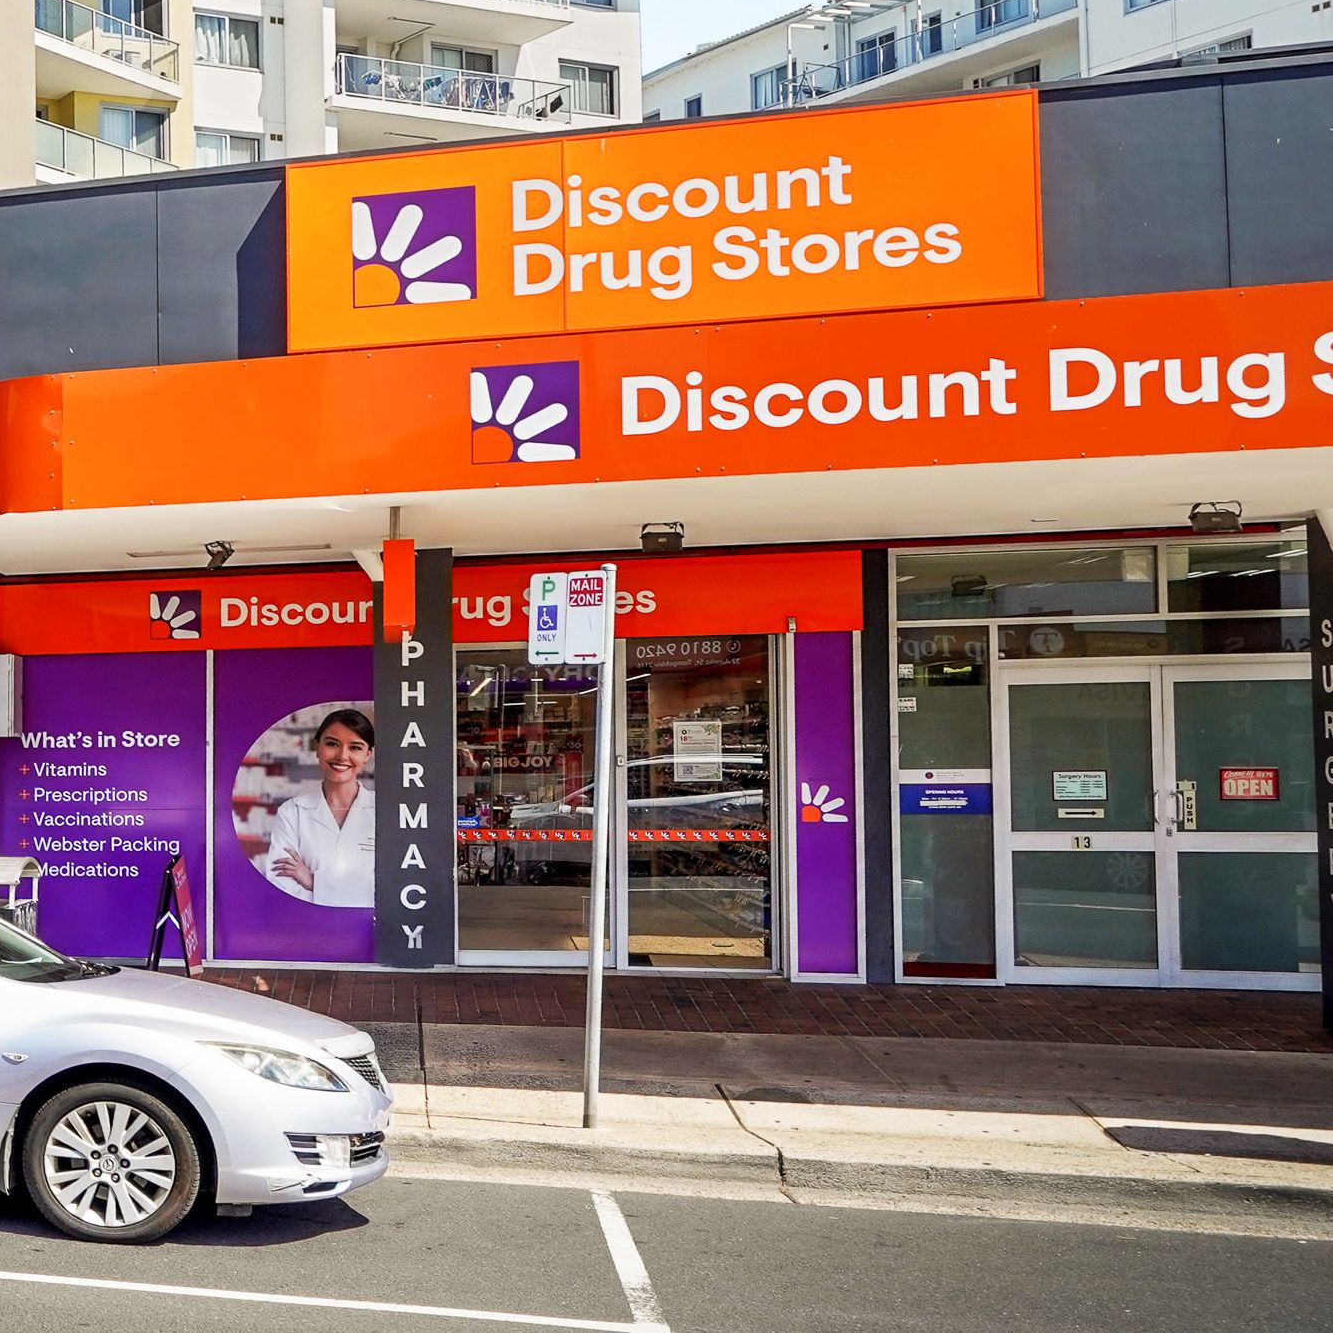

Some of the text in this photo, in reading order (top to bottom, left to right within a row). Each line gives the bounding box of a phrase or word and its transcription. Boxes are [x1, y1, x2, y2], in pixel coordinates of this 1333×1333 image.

[512, 155, 852, 233] Discount
[513, 222, 963, 301] Drug Stores
[620, 357, 1018, 437] Discount
[1048, 346, 1286, 419] Drug
[541, 579, 556, 601] P
[570, 578, 602, 592] MAIL
[569, 592, 603, 606] ZONE
[220, 596, 373, 628] Discoun
[536, 633, 557, 642] ONLY
[21, 730, 181, 748] What’s in Store
[33, 762, 108, 777] Vitamins
[494, 755, 554, 768] BIG JOY
[33, 787, 148, 805] Prescriptions
[399, 631, 429, 949] PHARMACY
[1223, 778, 1274, 797] OPEN
[33, 811, 145, 827] Vaccinations
[1186, 796, 1194, 824] PUSH
[33, 836, 181, 855] Webster Packing
[1074, 836, 1091, 849] 13
[39, 862, 139, 877] Medications
